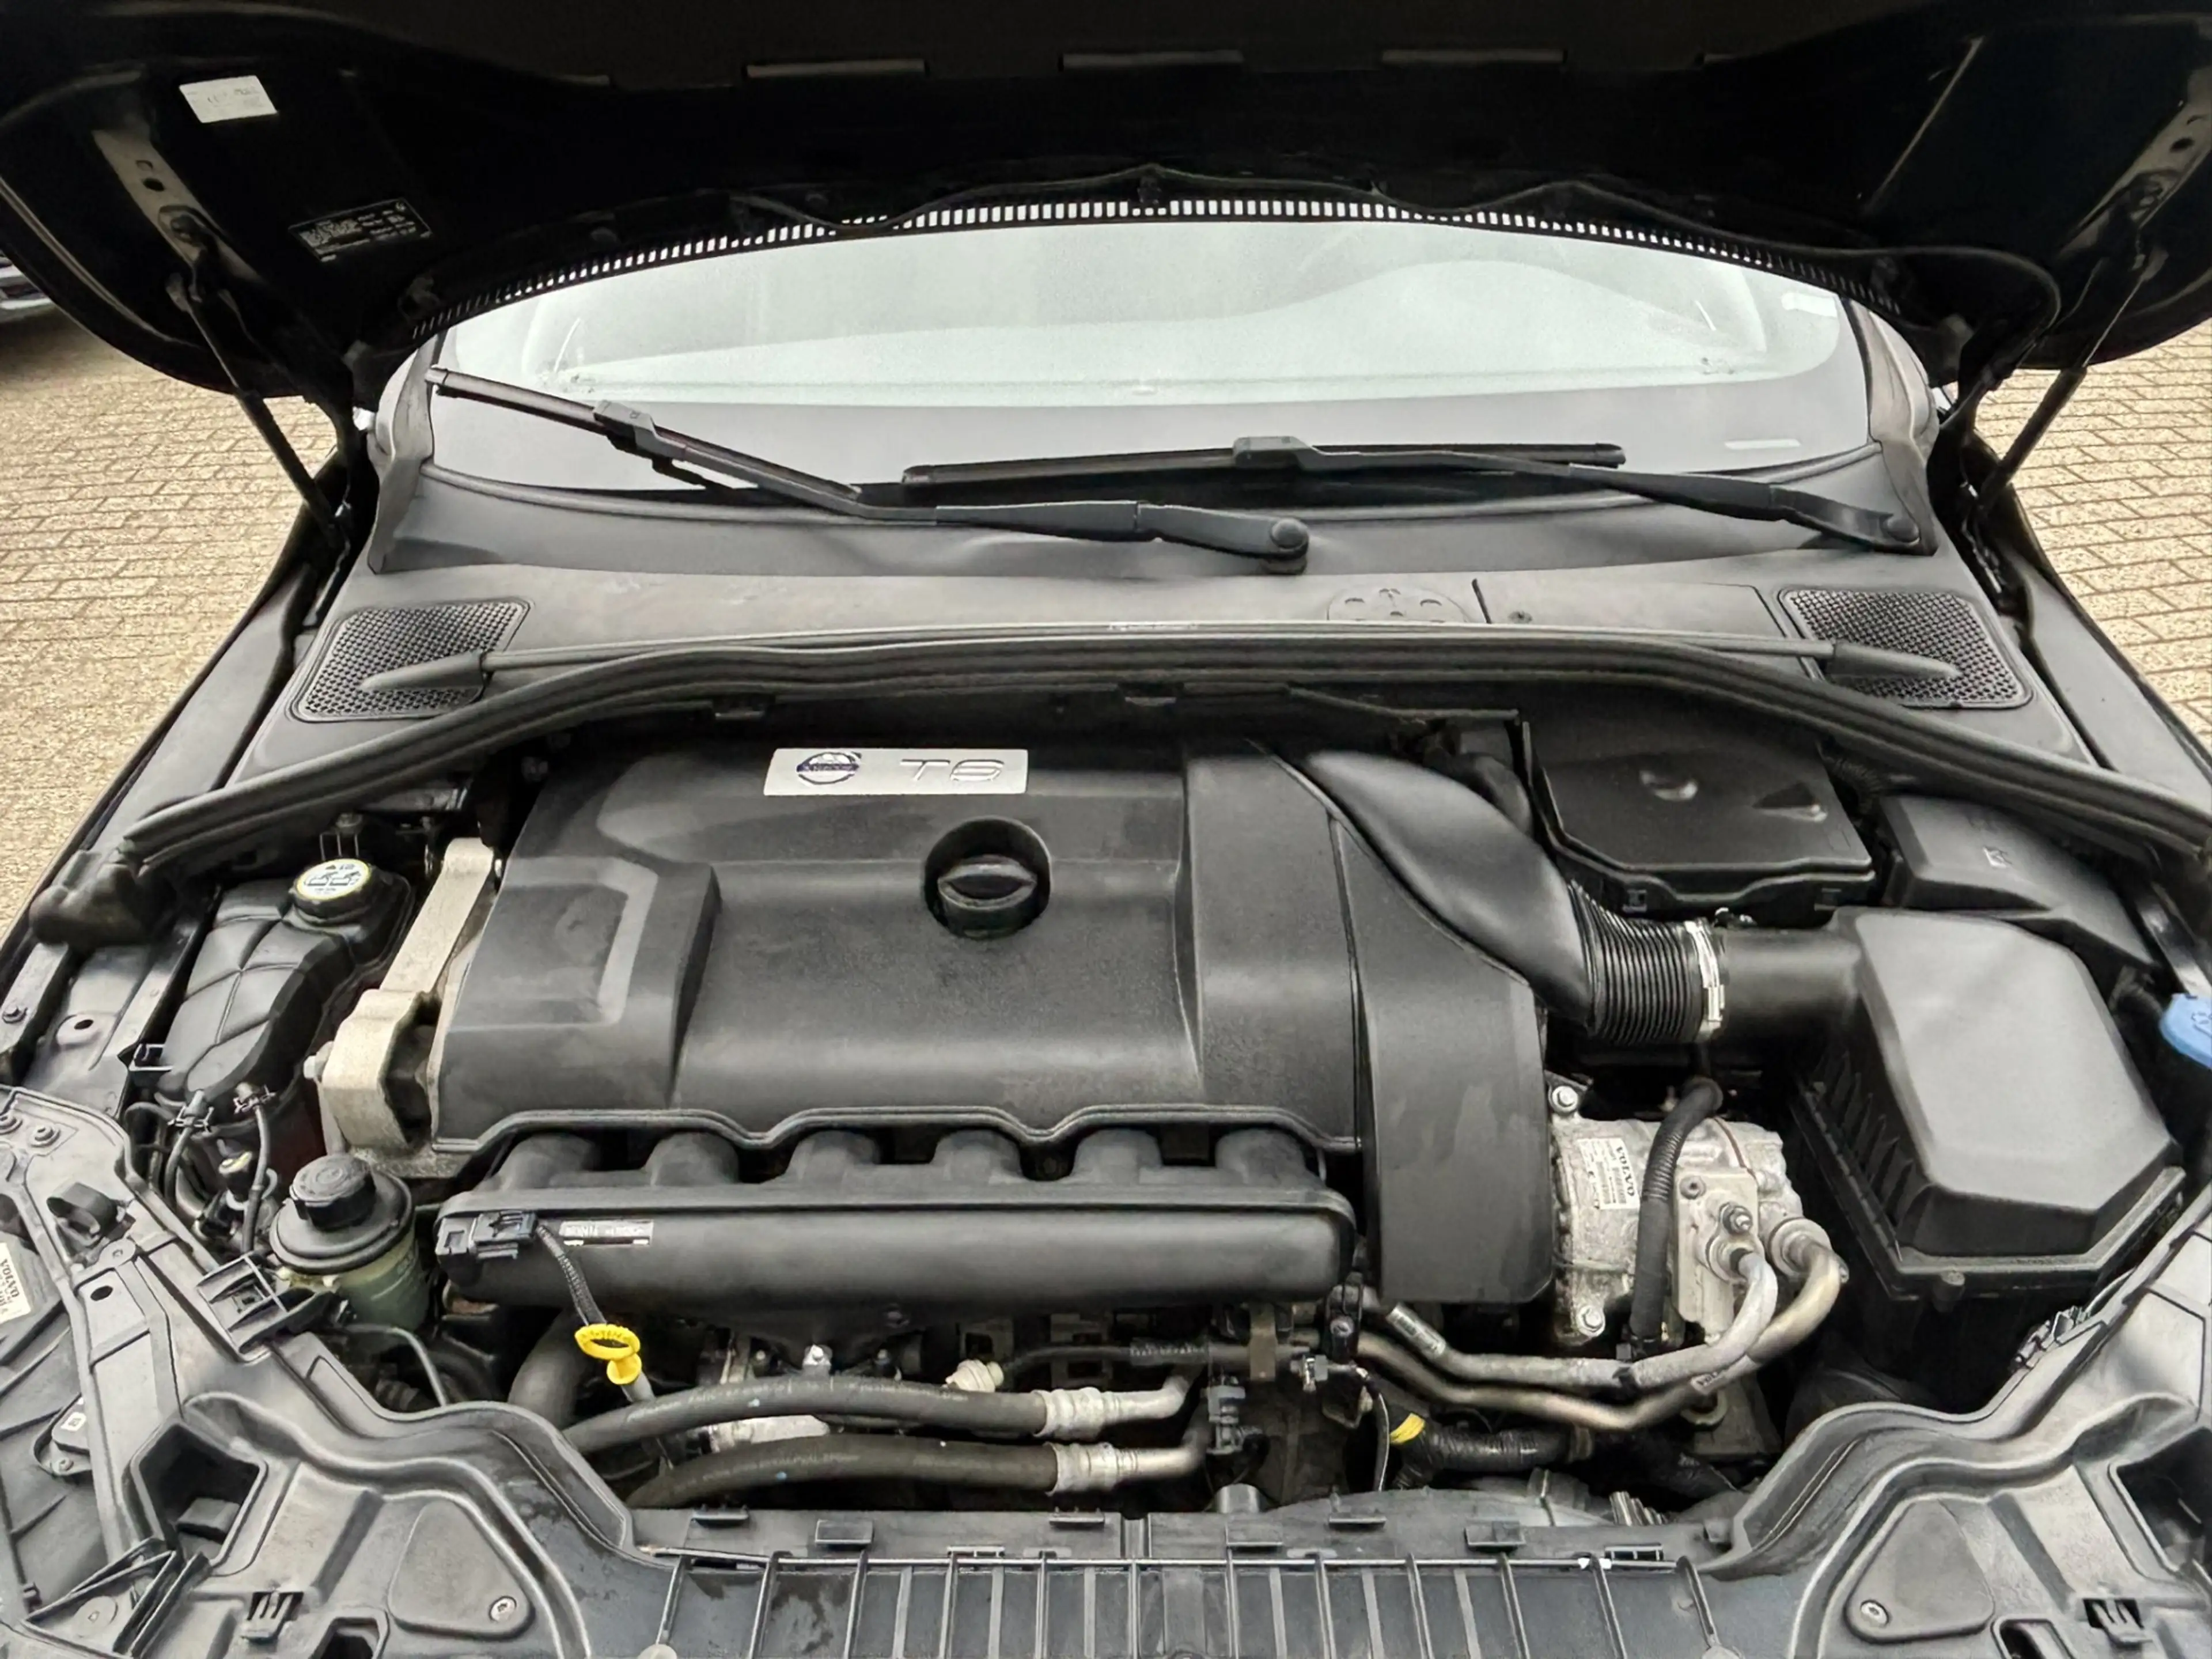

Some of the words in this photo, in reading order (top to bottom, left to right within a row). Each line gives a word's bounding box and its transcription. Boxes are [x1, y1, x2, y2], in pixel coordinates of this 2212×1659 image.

[900, 759, 1005, 782] T6
[1616, 1146, 1635, 1196] VOLVO
[1, 1259, 20, 1297] VOLVO
